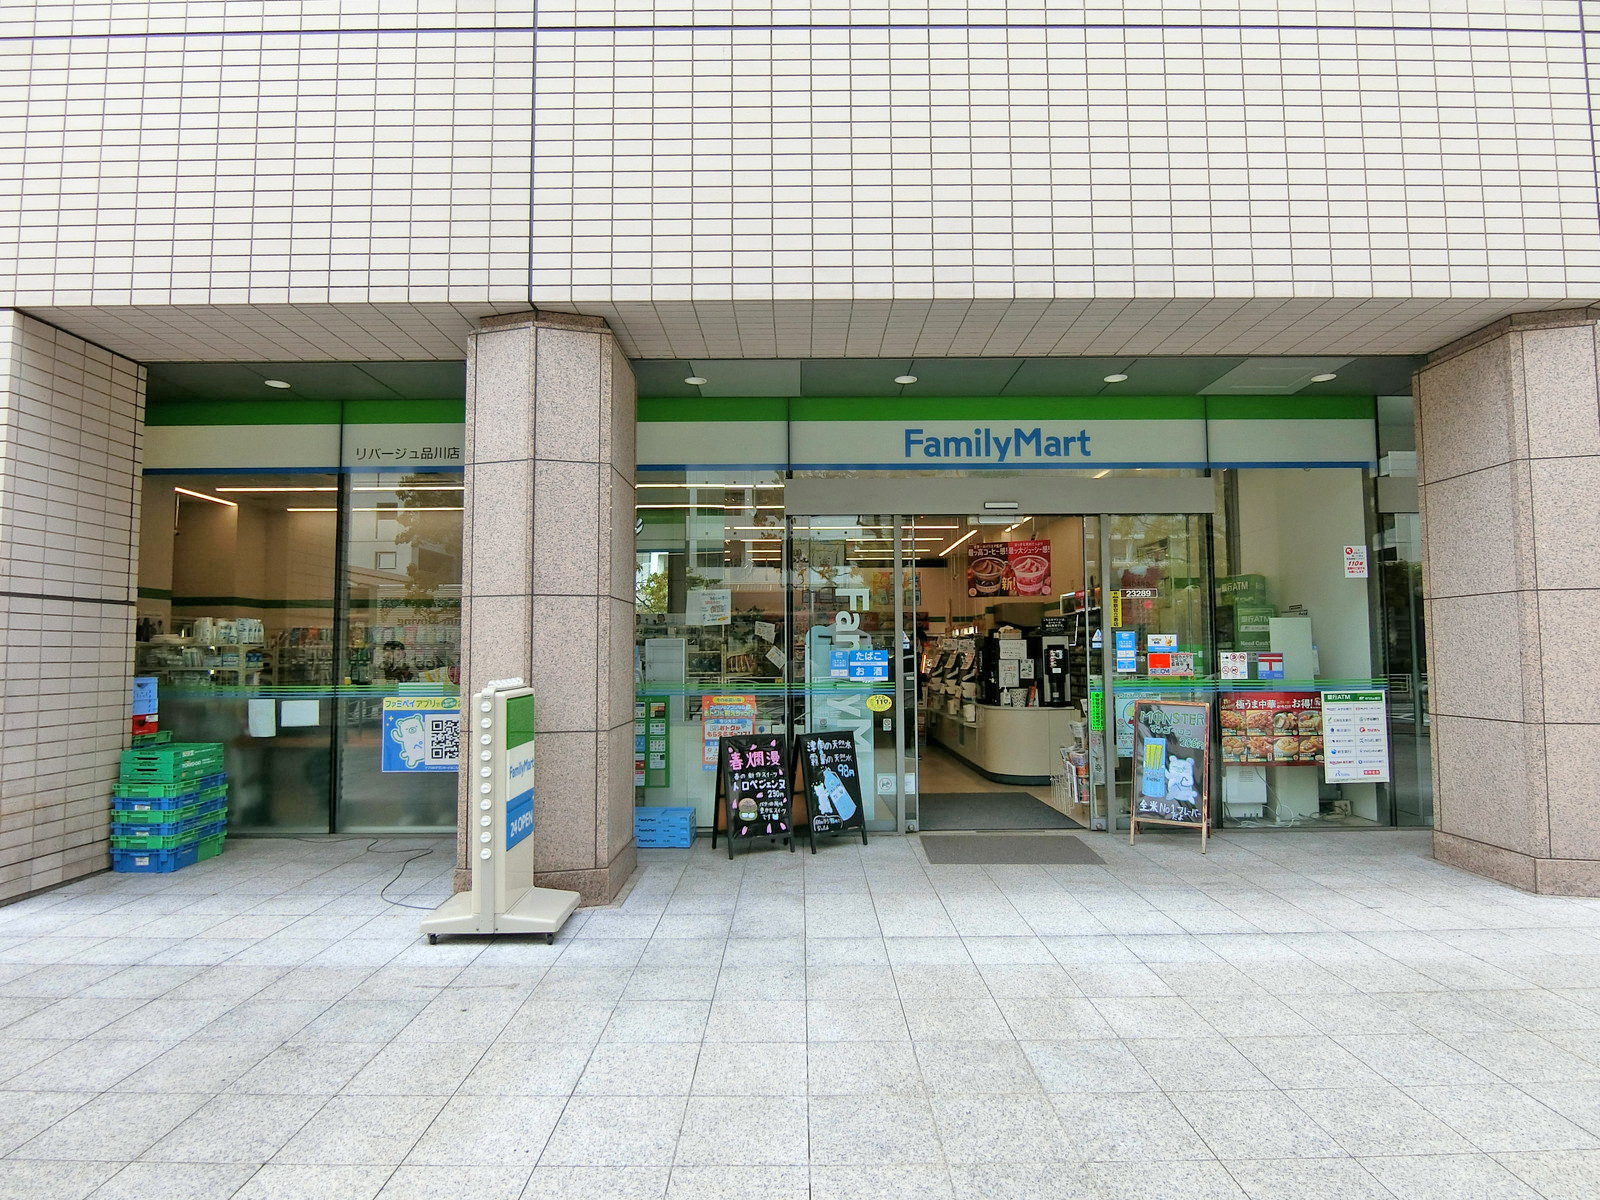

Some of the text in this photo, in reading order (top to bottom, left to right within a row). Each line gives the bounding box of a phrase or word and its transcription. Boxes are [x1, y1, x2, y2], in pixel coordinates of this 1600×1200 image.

[904, 427, 1092, 462] FamilyMart
[356, 446, 461, 461] リバージュ品川店
[855, 652, 882, 660] たばこ
[855, 667, 883, 676] お酒
[1235, 699, 1277, 709] 極うま中華
[1291, 698, 1313, 709] お得!
[1140, 711, 1205, 726] MONSTER
[730, 751, 781, 770] 春爛漫
[509, 760, 535, 779] FamilyMart
[510, 810, 534, 838] 24 OPEN
